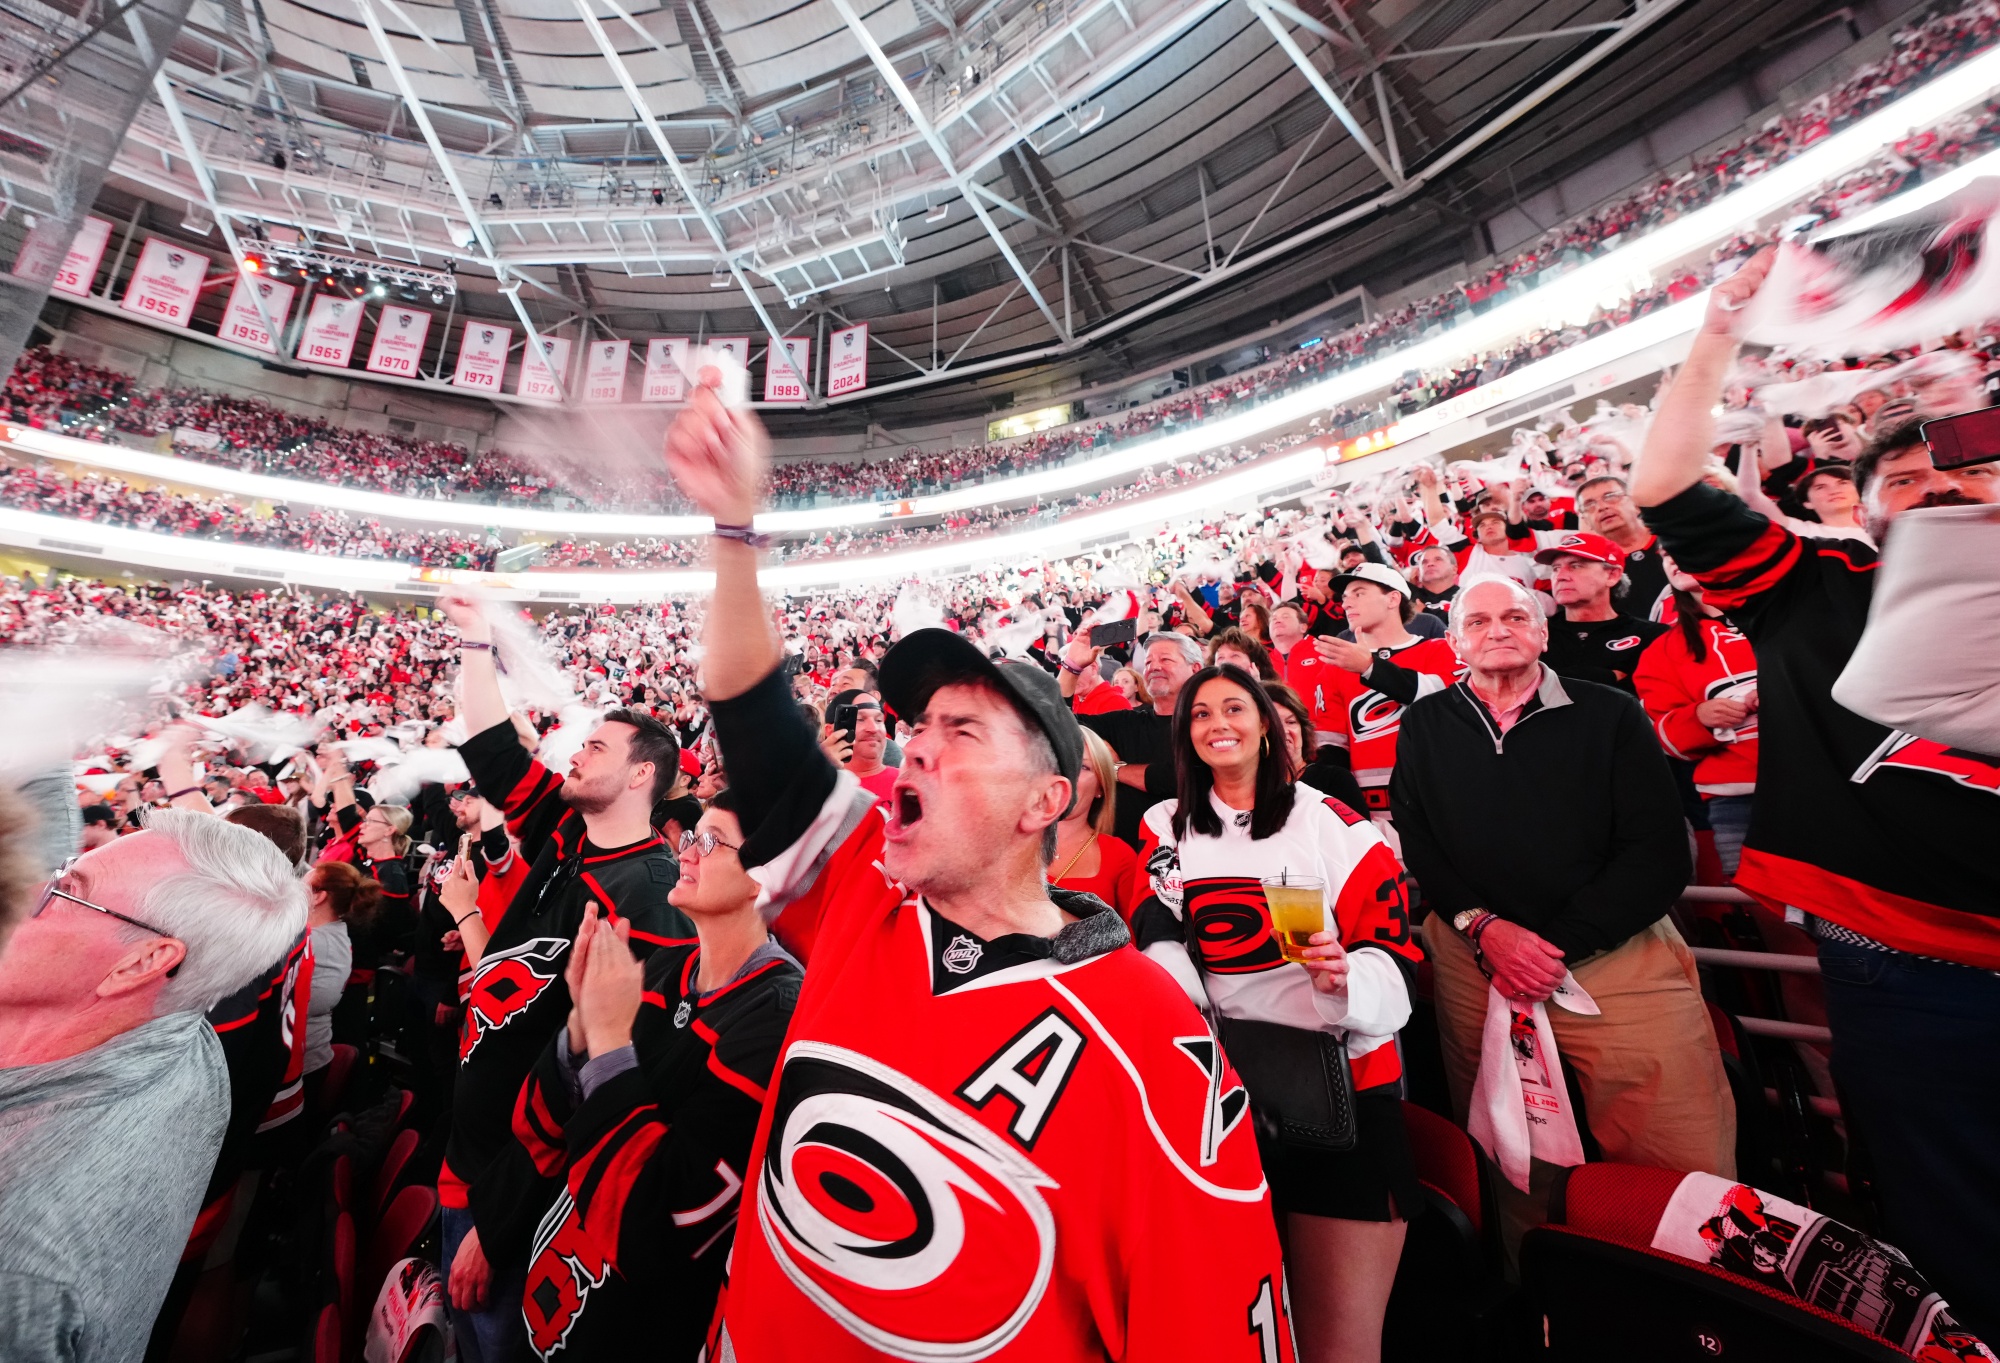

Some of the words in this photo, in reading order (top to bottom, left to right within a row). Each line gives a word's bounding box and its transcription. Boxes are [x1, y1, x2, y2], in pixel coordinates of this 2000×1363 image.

[137, 295, 180, 318] 1956
[232, 324, 271, 344] 1959
[380, 338, 417, 349] CHAMPIONS
[309, 344, 342, 359] 1965
[378, 355, 410, 370] 1970
[465, 353, 500, 365] CHAMPIONS
[833, 356, 862, 368] CHAMPIONS
[464, 371, 494, 385] 1973
[833, 372, 861, 390] 2024
[527, 381, 555, 395] 1974
[590, 387, 616, 399] 1983
[649, 385, 677, 396] 1985
[773, 385, 800, 396] 1989
[1315, 468, 1333, 482] 128
[1374, 871, 1411, 947] 3
[953, 1005, 1088, 1152] A
[1820, 1233, 1845, 1252] 20
[1892, 1276, 1921, 1297] 26
[1698, 1334, 1716, 1351] 12
